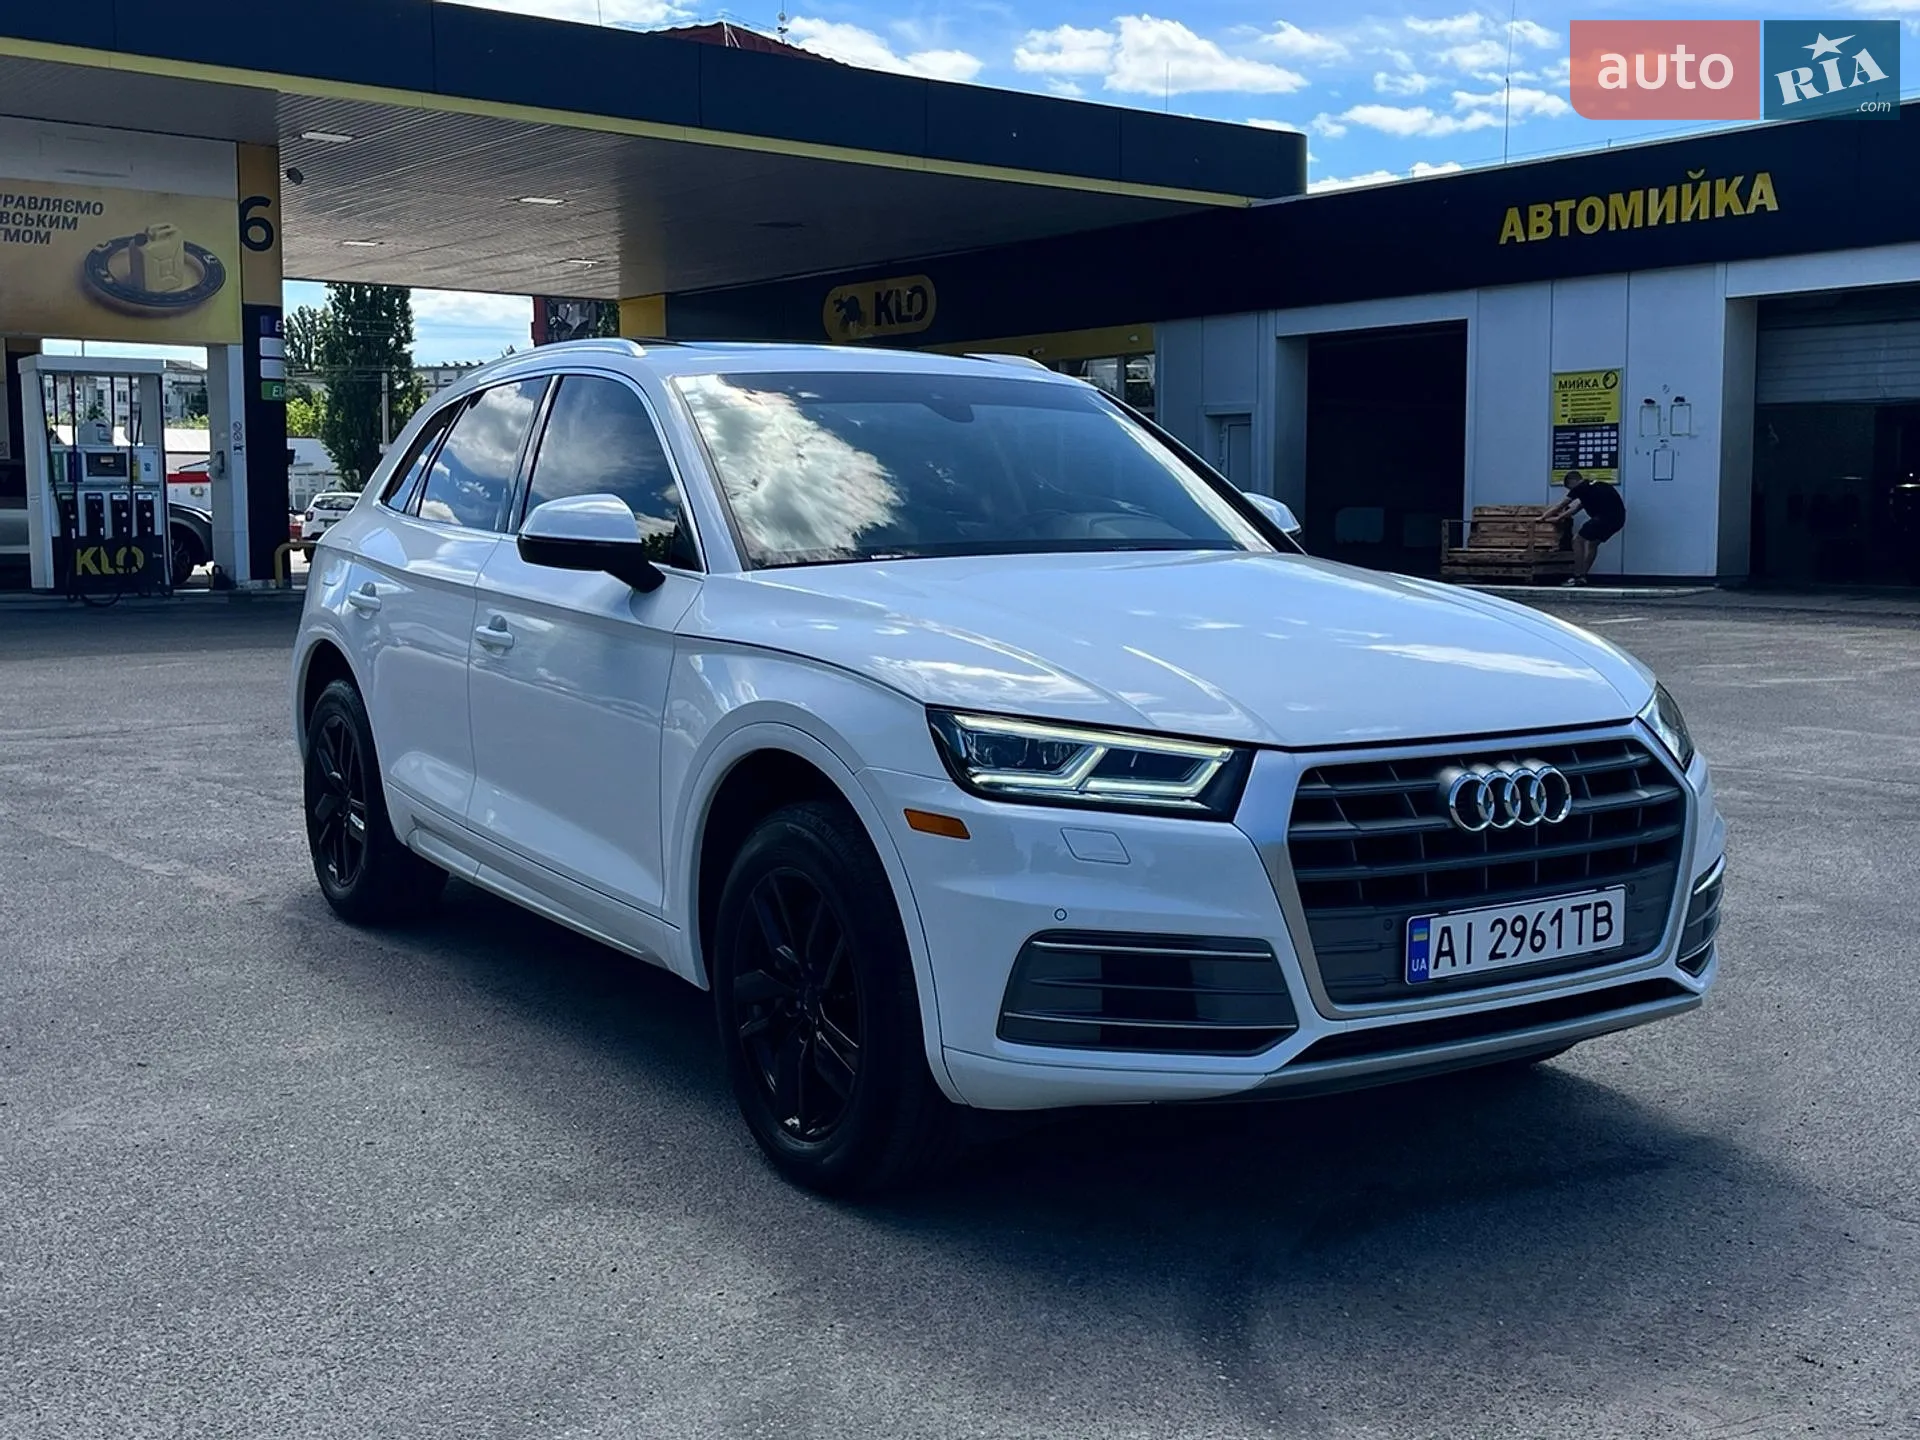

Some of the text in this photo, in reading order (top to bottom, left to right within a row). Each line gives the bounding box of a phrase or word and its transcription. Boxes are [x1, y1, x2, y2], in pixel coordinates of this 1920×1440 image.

[0, 193, 104, 216] РАВЛЯЄМО
[1499, 168, 1779, 245] АВТОМИЙКА
[0, 228, 52, 245] МОМ
[239, 196, 274, 251] 6
[874, 285, 928, 326] KLO
[1558, 377, 1599, 390] МИЙКА
[76, 545, 144, 576] KLO
[1433, 921, 1472, 970] AI
[1411, 958, 1427, 972] UA
